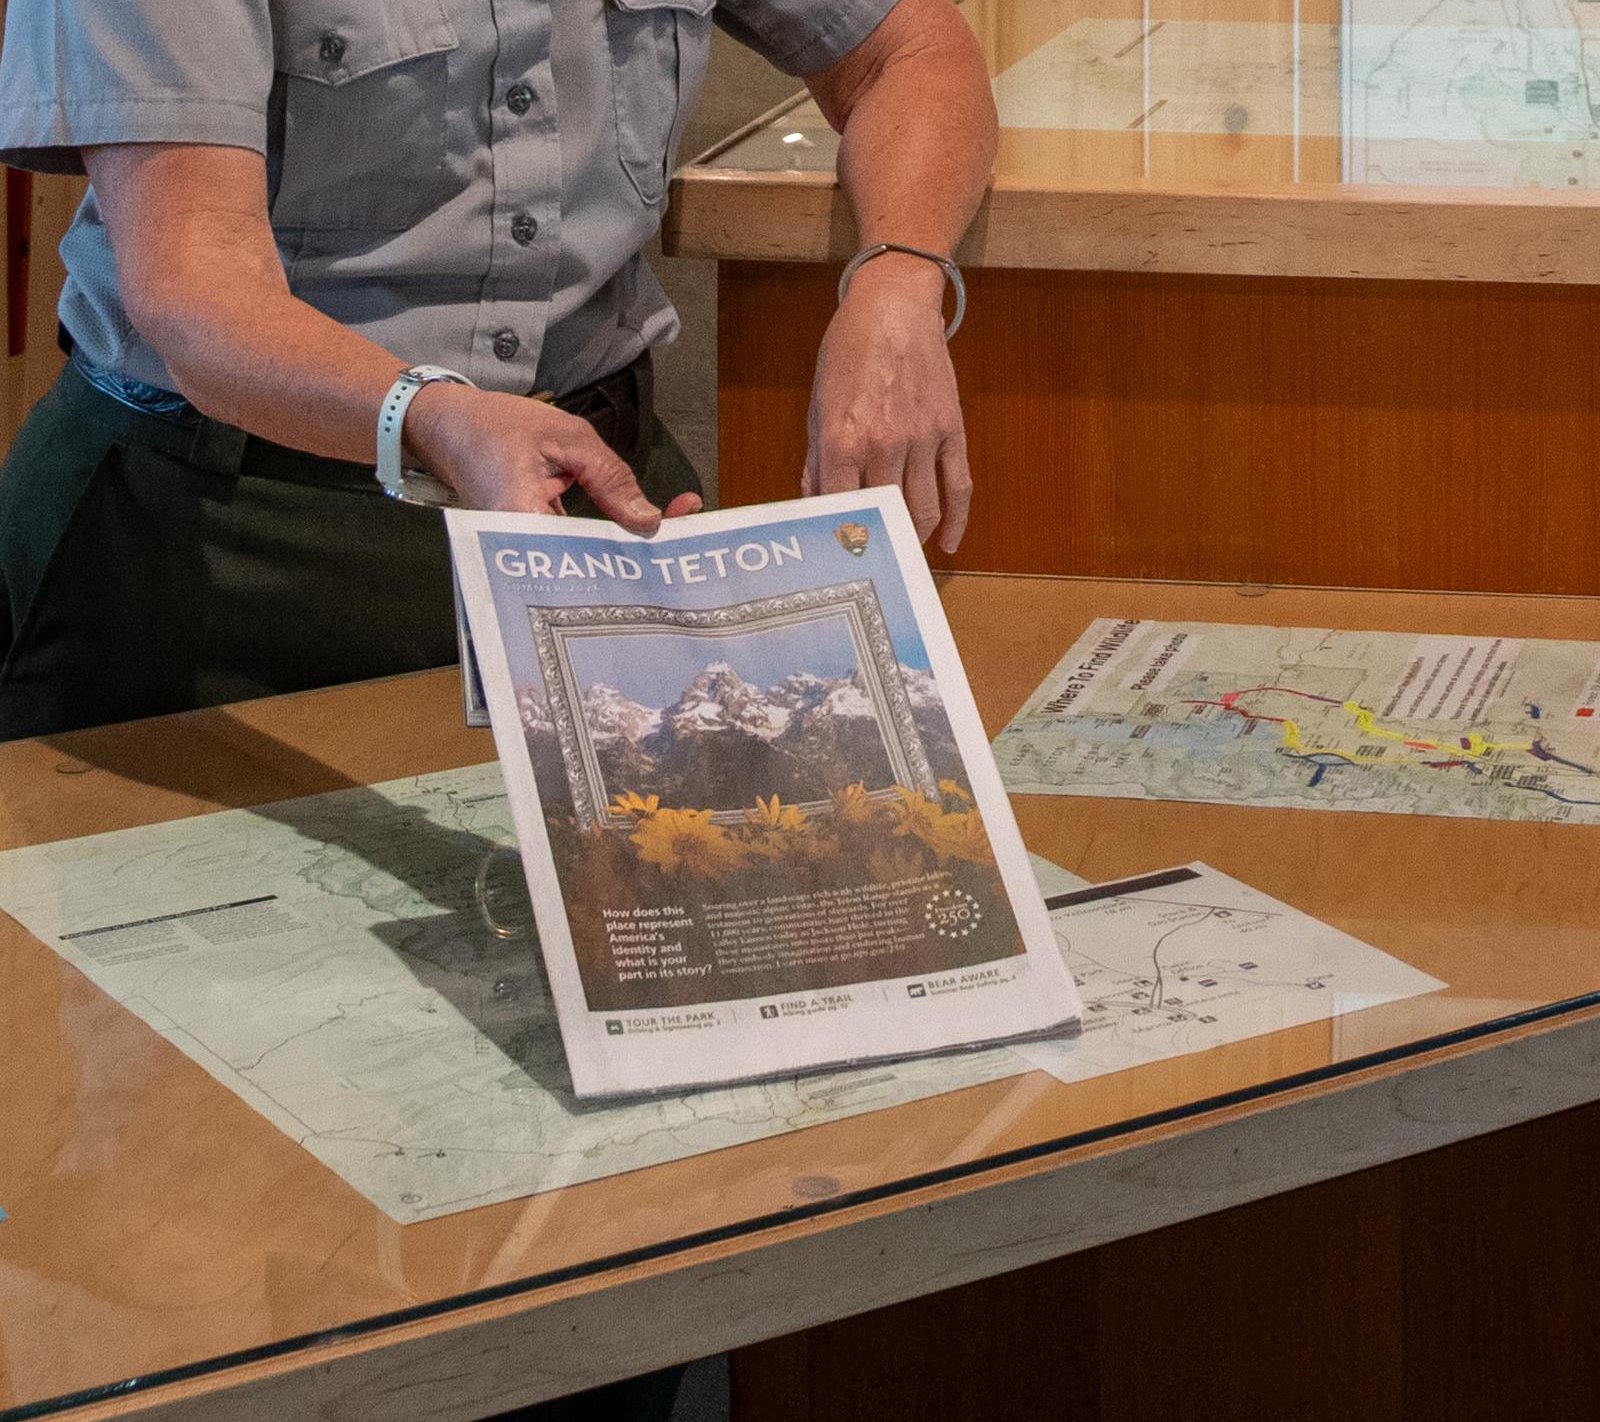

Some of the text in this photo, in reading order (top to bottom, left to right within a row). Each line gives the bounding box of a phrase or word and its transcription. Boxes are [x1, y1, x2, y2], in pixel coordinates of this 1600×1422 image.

[496, 534, 804, 585] GRAND TETON
[1042, 618, 1141, 715] Where To Find Wildlife
[602, 905, 685, 919] How does this
[606, 918, 694, 932] place represent
[609, 932, 666, 943] America's
[611, 942, 683, 957] identity and
[615, 955, 689, 970] what is your
[619, 964, 713, 982] part in its story?
